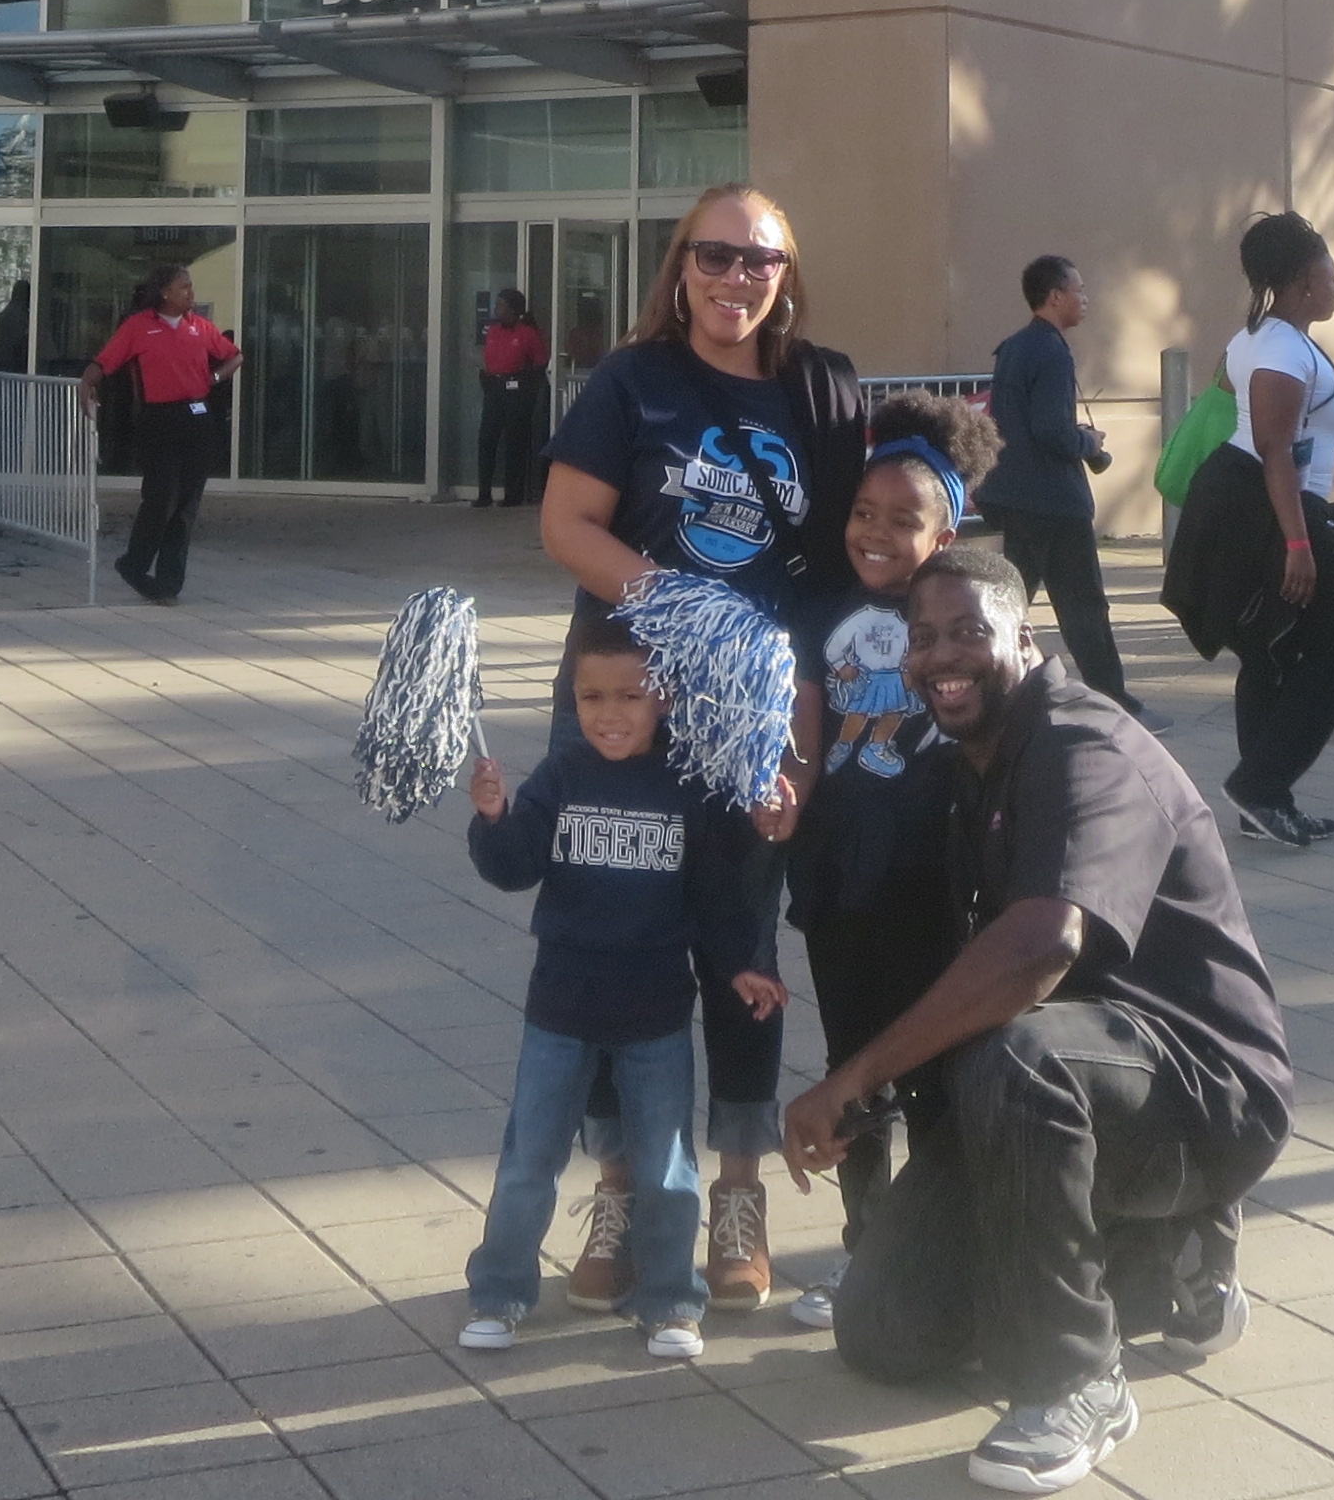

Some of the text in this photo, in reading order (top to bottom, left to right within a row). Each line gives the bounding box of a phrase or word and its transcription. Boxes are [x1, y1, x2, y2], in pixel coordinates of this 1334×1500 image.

[697, 465, 796, 509] SONIC BM
[736, 503, 763, 524] YEAR
[565, 804, 669, 822] JACKSON STATE UNIVERSITY
[551, 812, 686, 872] TIGERS
